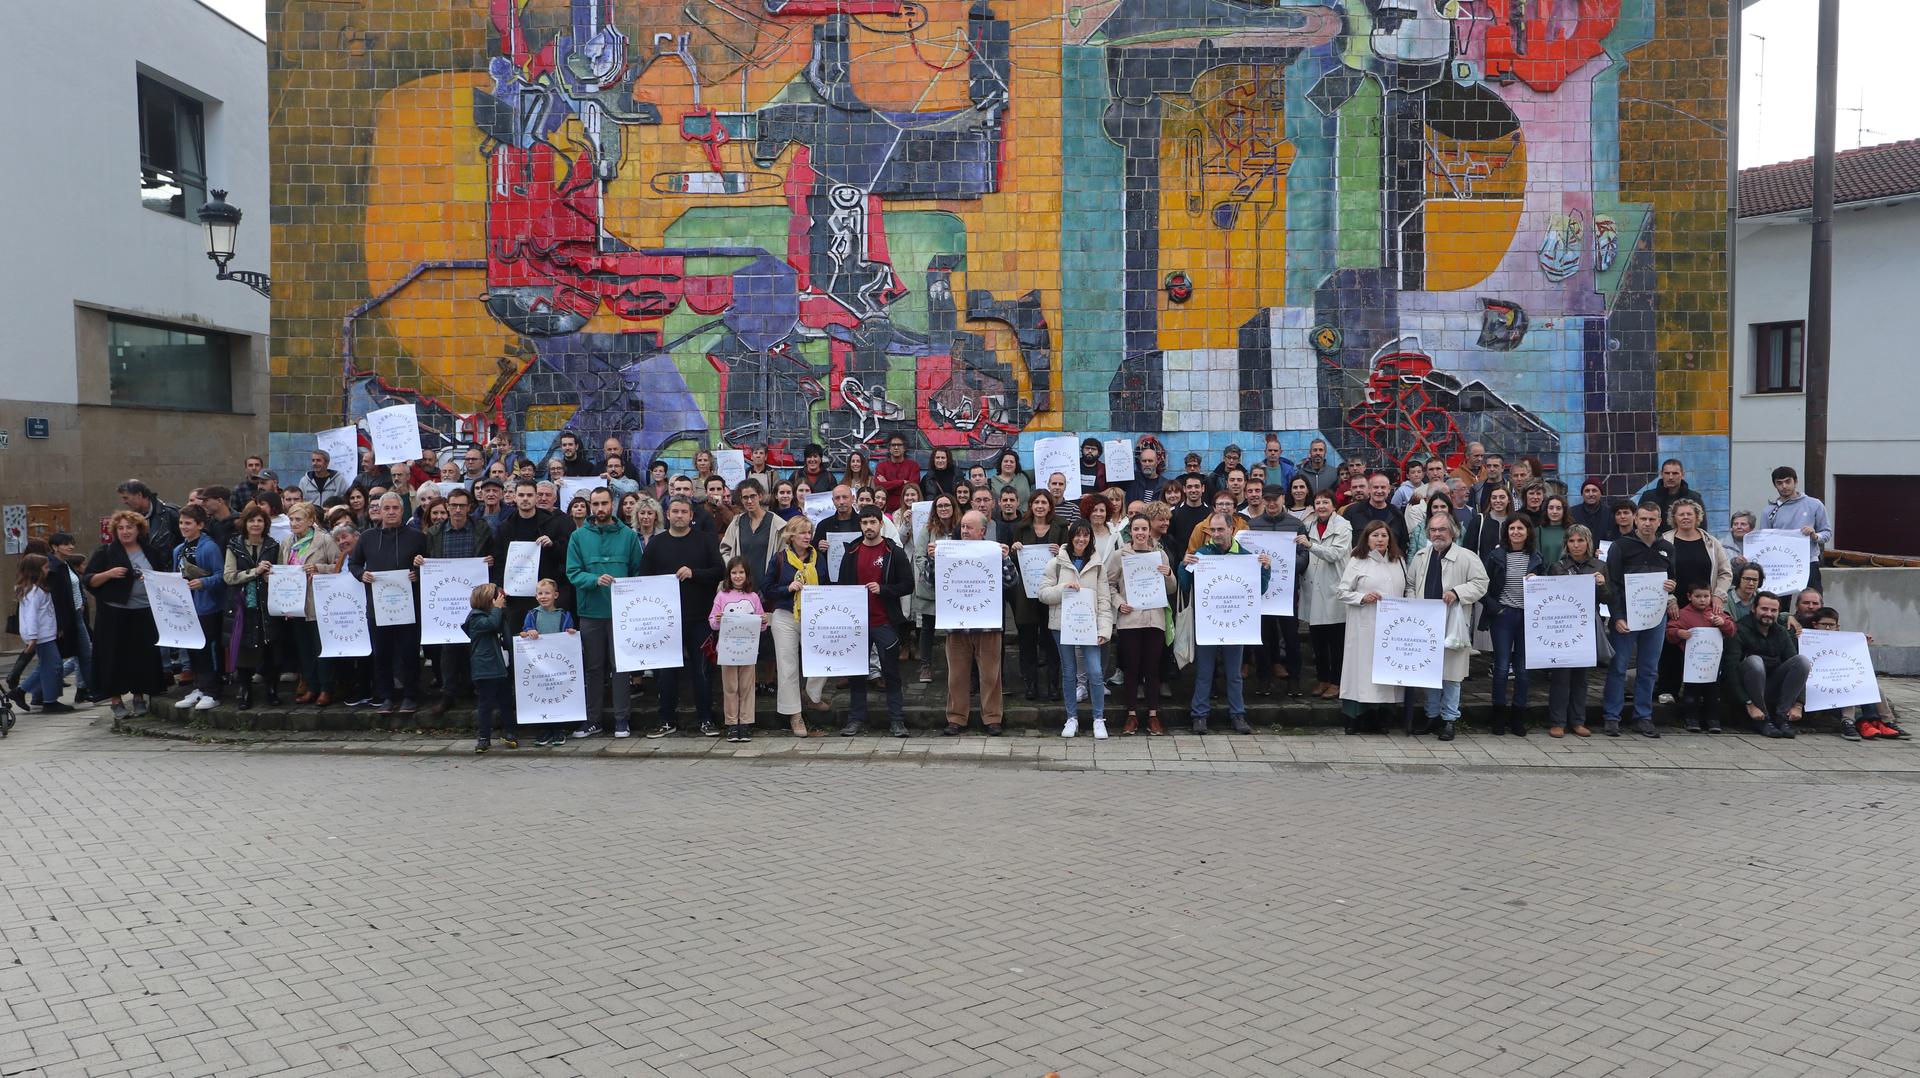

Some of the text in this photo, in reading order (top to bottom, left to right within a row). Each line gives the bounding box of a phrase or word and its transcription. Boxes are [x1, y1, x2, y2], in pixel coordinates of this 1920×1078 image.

[1254, 549, 1288, 581] RALDIAREN
[1751, 545, 1803, 575] DARRALDIAREN
[943, 559, 995, 592] OLDARRALDIAREN
[947, 598, 991, 613] AURREAN
[1201, 574, 1254, 608] OLDARRALDIAREN
[433, 616, 461, 630] AURR
[621, 595, 674, 630] OLDARRALDIAREN
[808, 604, 862, 638] OLDARRALDIAREN
[1206, 613, 1250, 628] AURREAN
[1532, 594, 1588, 628] OLDARRALDIAREN
[625, 634, 670, 650] AURREAN
[1381, 616, 1437, 652] OLDARRALDIAREN
[1536, 633, 1584, 649] AURREAN
[813, 642, 857, 657] AURREAN
[1385, 655, 1431, 672] AURREAN
[523, 652, 577, 686] OLDARRALDIAREN
[528, 688, 574, 704] AURREAN
